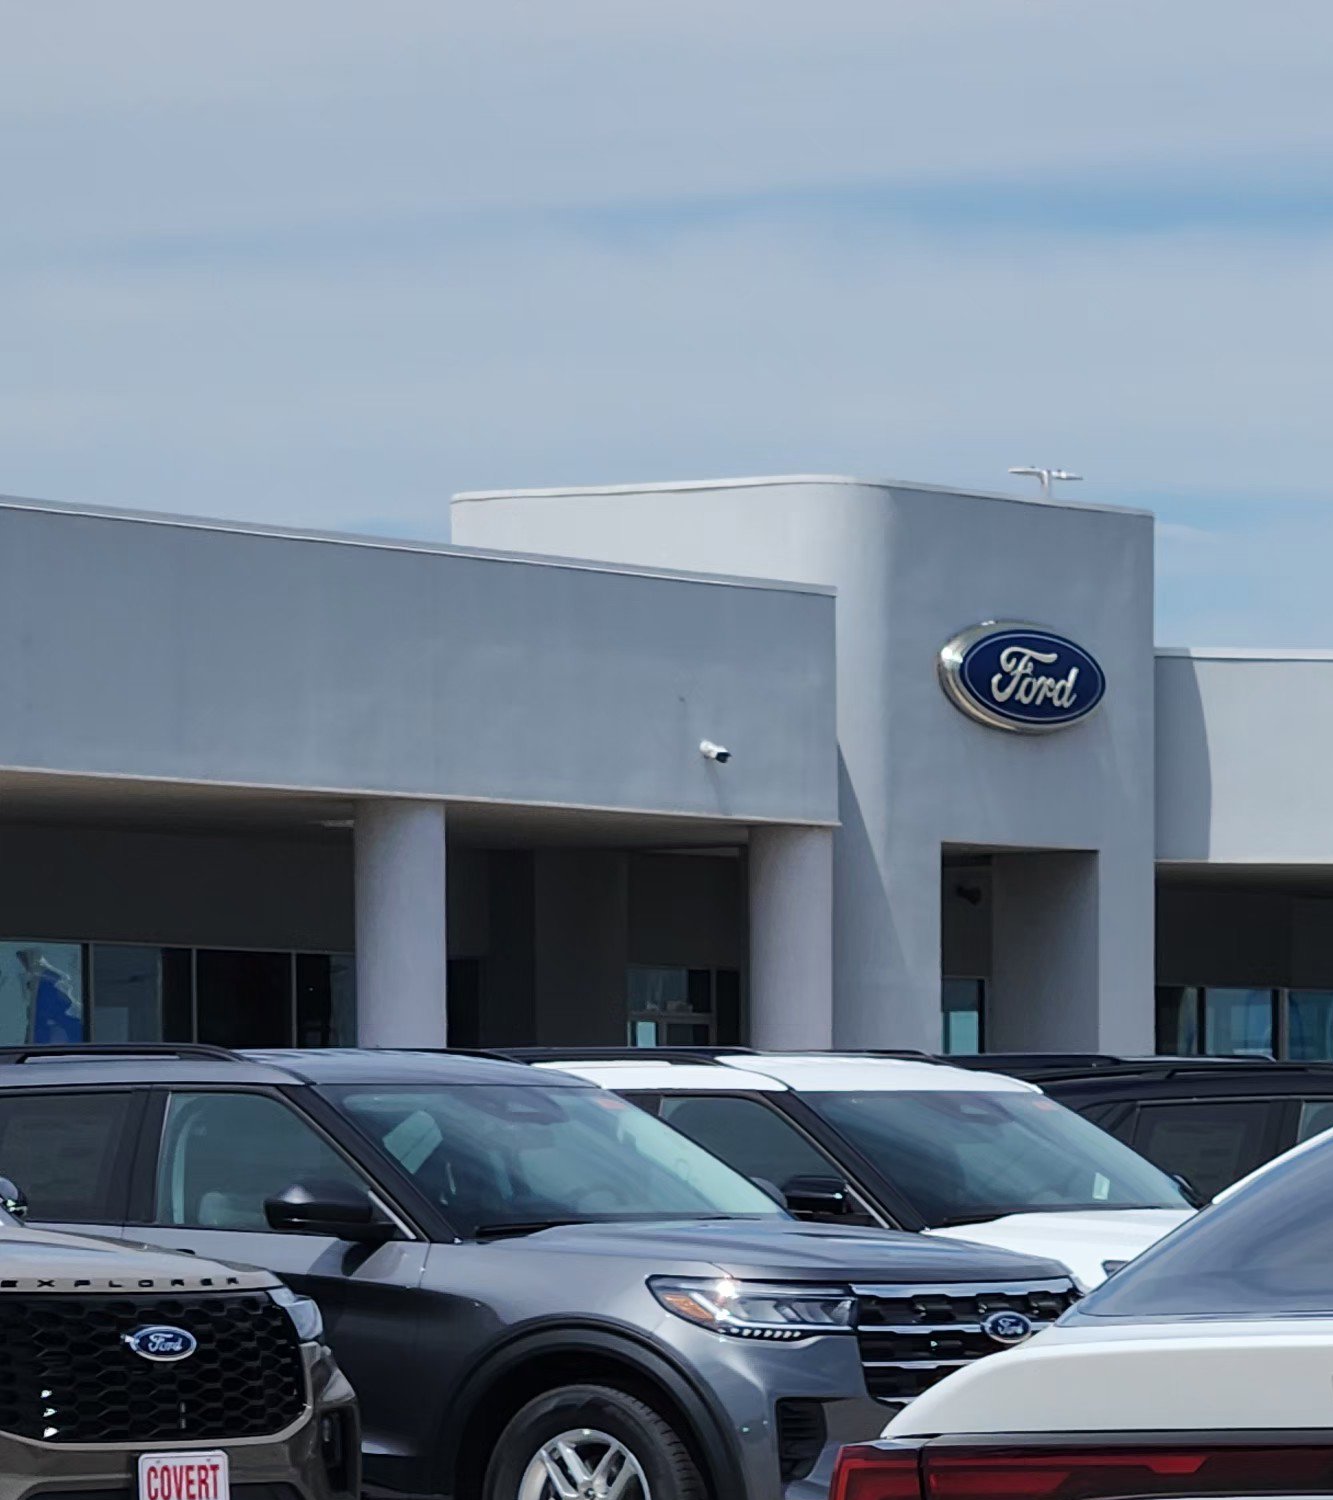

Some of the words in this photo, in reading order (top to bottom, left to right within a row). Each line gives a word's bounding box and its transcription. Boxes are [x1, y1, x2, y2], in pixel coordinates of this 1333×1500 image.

[991, 646, 1079, 708] Ford
[0, 1277, 239, 1288] EXPLORER
[147, 1333, 183, 1352] Ford
